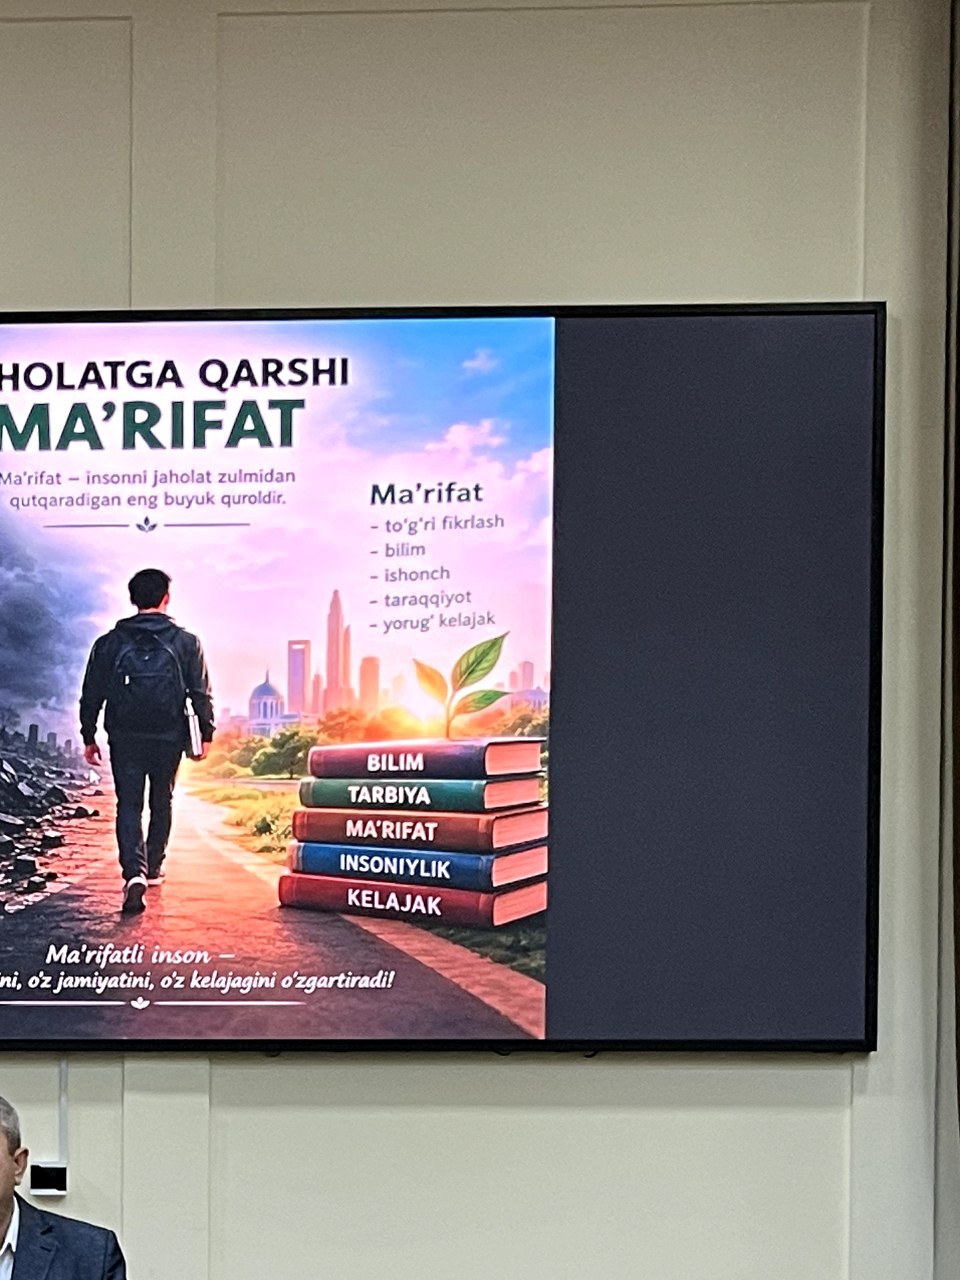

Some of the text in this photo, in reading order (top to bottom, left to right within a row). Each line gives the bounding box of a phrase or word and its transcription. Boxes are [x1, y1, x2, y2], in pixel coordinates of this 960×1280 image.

[198, 357, 349, 392] QARSHI
[86, 470, 147, 485] insonni
[152, 469, 212, 488] jaholat
[218, 468, 296, 484] zulmidan
[10, 491, 287, 510] qutqaradigan eng buyuk quroldir.
[370, 481, 483, 505] Ma'rifat
[385, 517, 436, 535] to'g'ri
[442, 514, 505, 530] fikrlash
[385, 543, 426, 557] bilim
[385, 566, 450, 582] ishonch
[384, 591, 471, 608] taraqqiyot
[383, 614, 434, 634] yorug'
[439, 611, 496, 630] kelajak
[367, 753, 424, 772] BILIM
[348, 785, 431, 805] TARBIYA
[346, 820, 438, 841] MA'RIFAT
[340, 853, 450, 879] INSONIYLIK
[347, 888, 441, 915] KELAJAK
[46, 943, 143, 969] Ma'rifatli
[151, 945, 212, 964] inson
[28, 970, 52, 988] o'z
[53, 971, 154, 994] jamiyatini,
[160, 971, 185, 989] o'z
[190, 970, 276, 994] kelajagini
[281, 970, 396, 994] o'zgartiradi!
